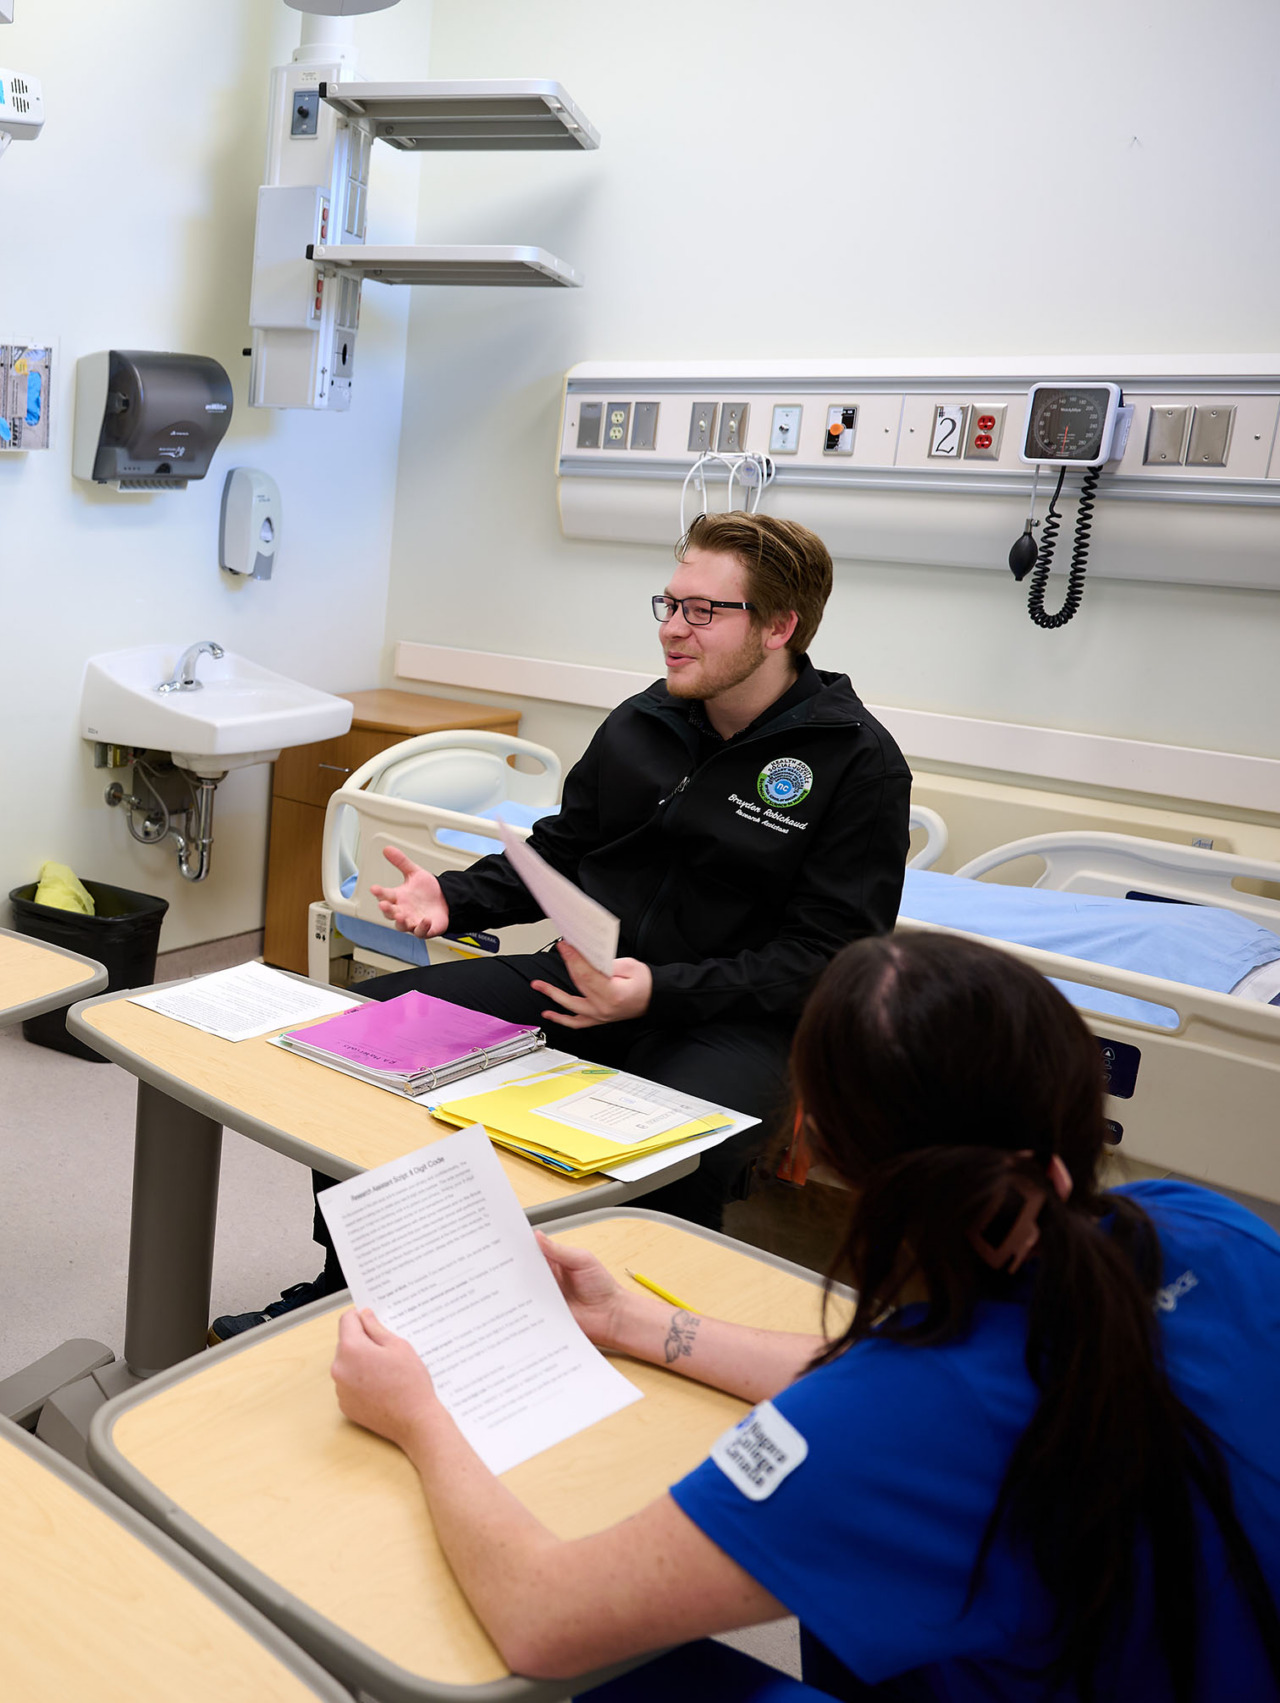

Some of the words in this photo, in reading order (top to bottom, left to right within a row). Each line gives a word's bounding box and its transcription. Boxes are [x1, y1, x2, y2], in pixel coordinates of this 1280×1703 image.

[935, 418, 957, 454] 2
[777, 783, 789, 791] nc
[728, 794, 761, 812] Brayden
[763, 808, 808, 830] Robichaud
[413, 1163, 428, 1174] Digit
[428, 1156, 445, 1167] Code
[737, 1432, 776, 1474] College
[750, 1421, 787, 1462] Niagara
